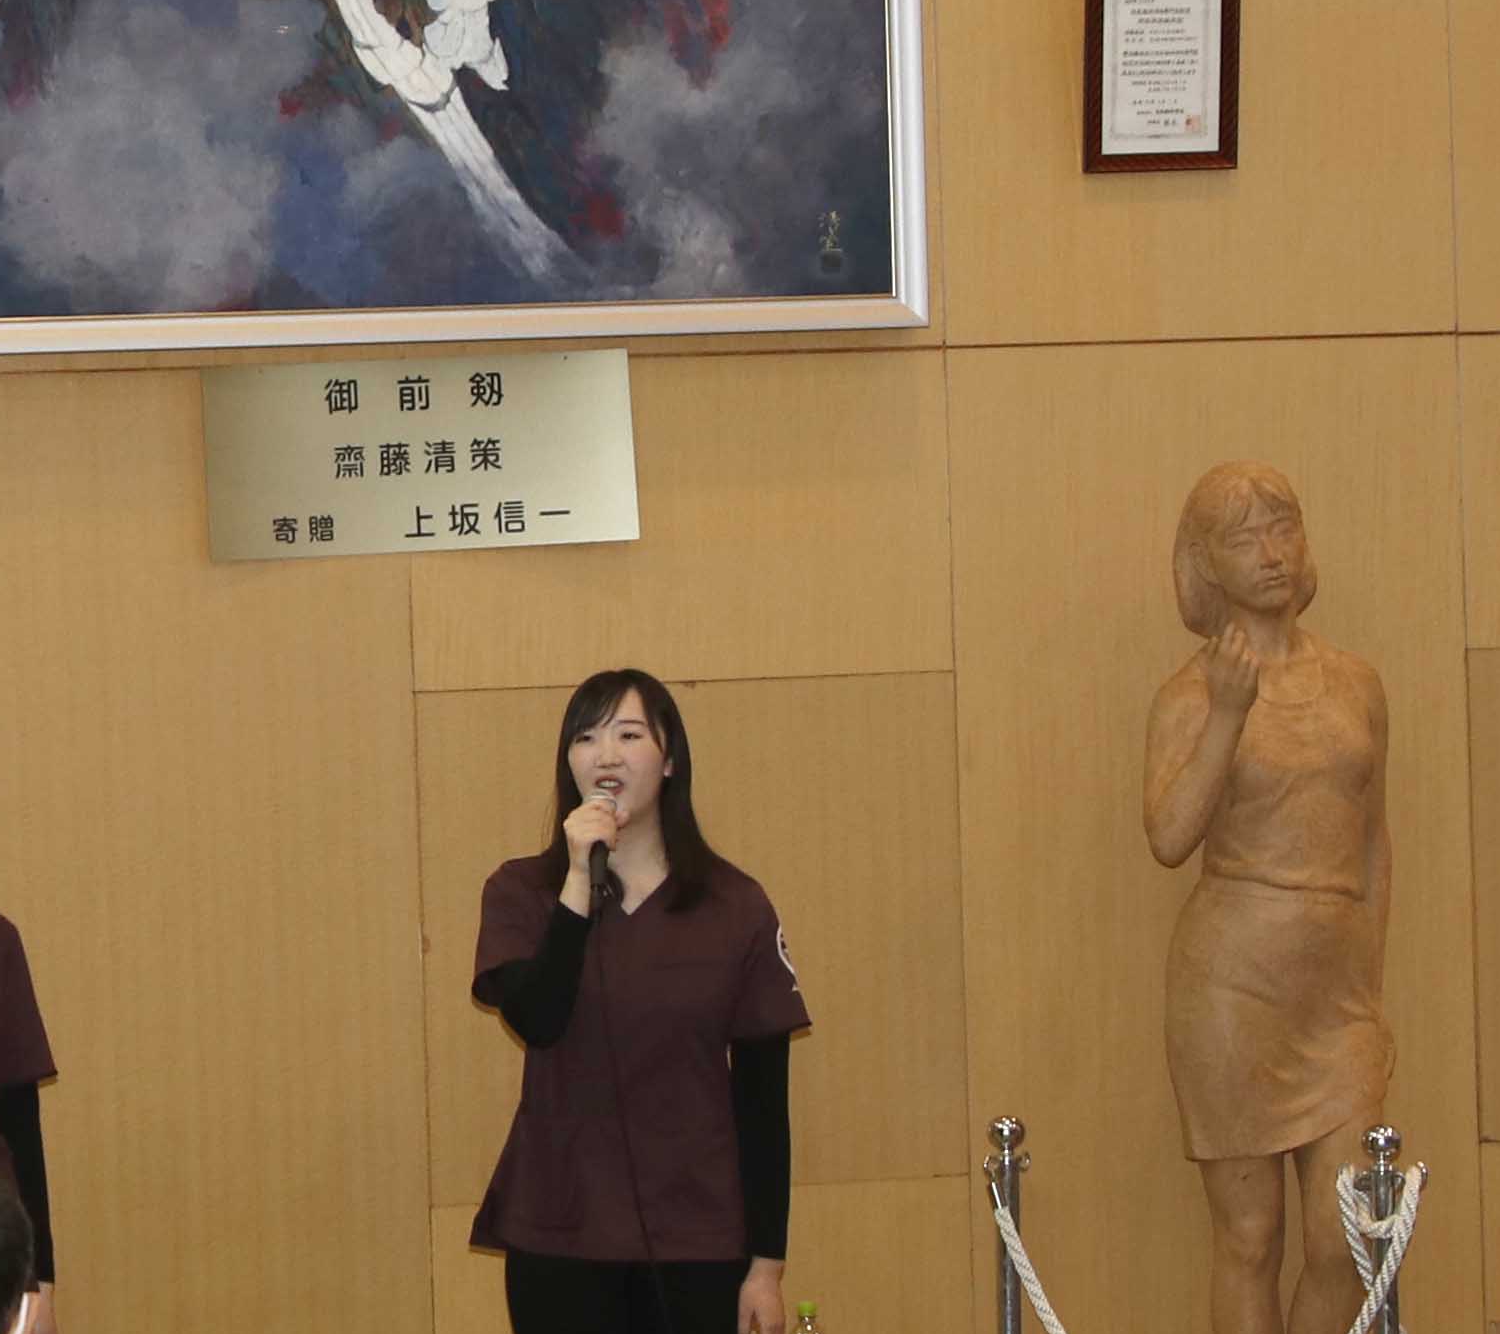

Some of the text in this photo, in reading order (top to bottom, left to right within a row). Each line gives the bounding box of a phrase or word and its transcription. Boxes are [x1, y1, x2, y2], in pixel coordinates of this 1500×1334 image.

[272, 500, 571, 545] 寄贈 上坂信一
